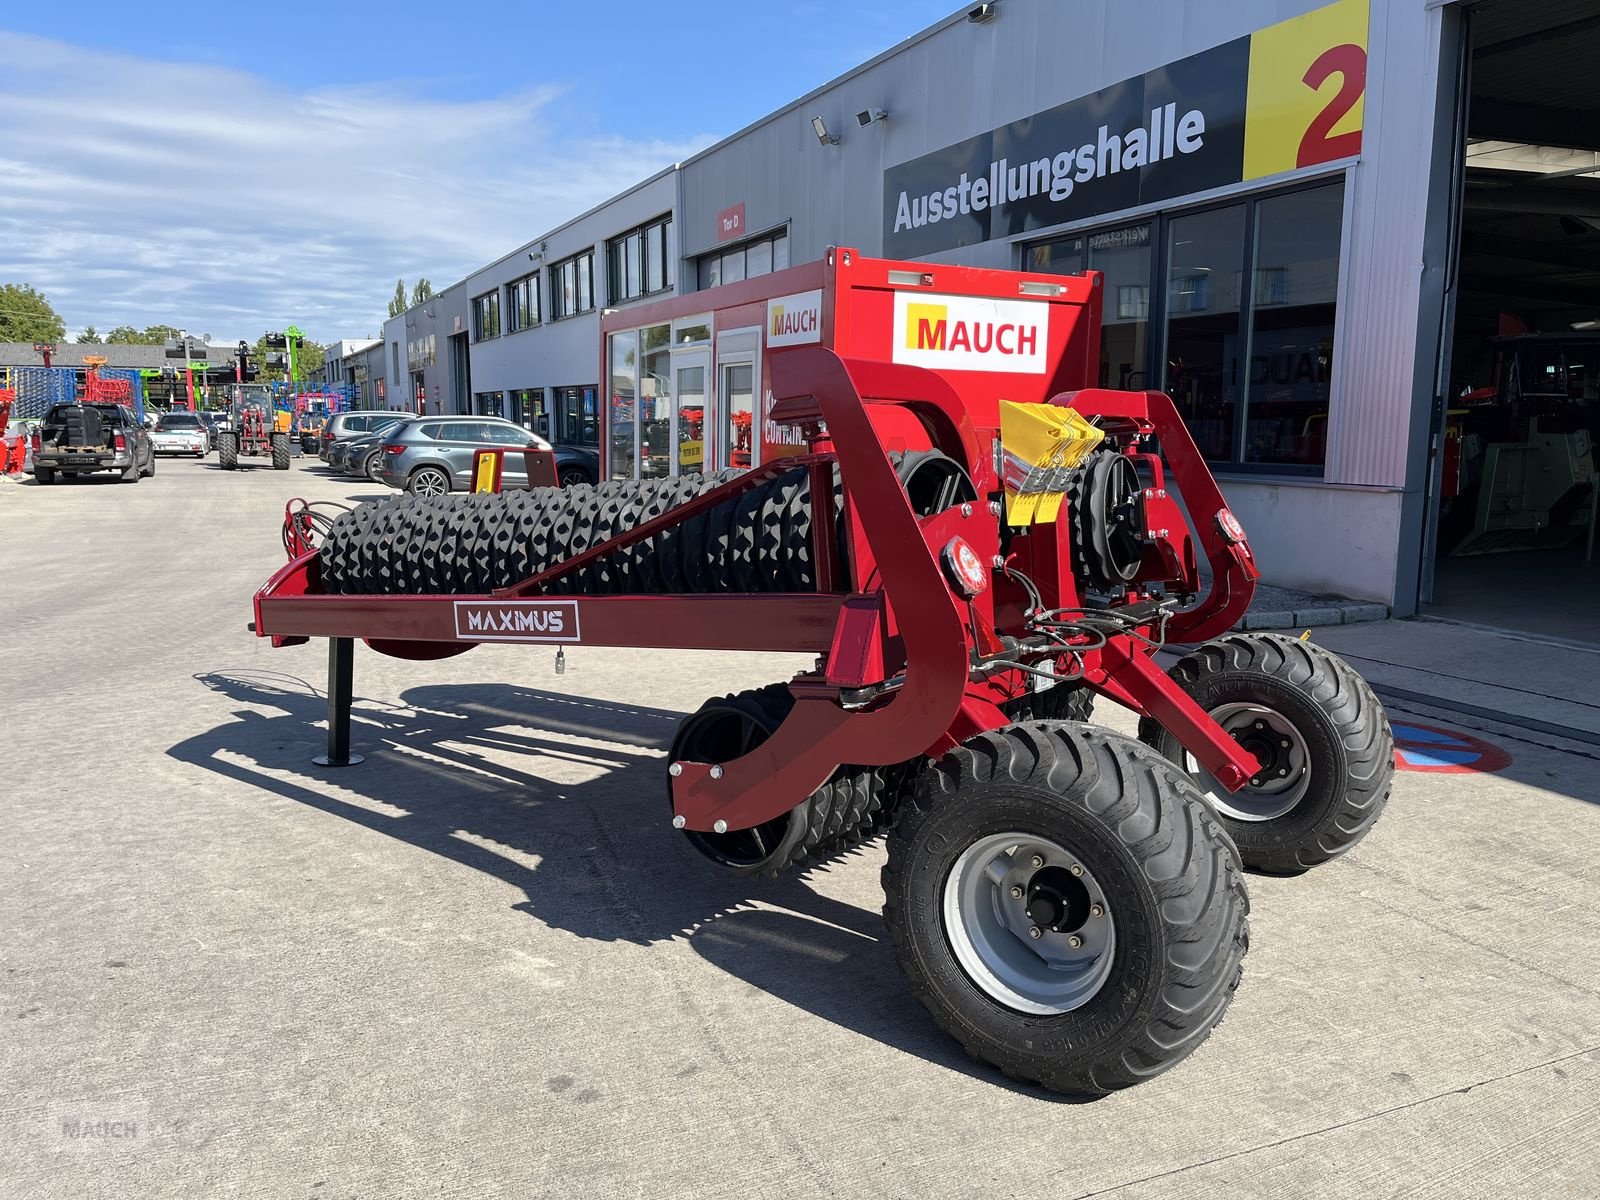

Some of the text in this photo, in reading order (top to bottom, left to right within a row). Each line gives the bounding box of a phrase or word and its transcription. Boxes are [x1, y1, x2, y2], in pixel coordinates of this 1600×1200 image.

[893, 43, 1367, 232] Ausstellungshalle 2
[723, 214, 739, 231] Tor D
[774, 308, 817, 336] MAUCH
[917, 318, 1037, 356] MAUCH
[765, 419, 807, 446] CONTAIN
[467, 609, 563, 632] MAXIMUS
